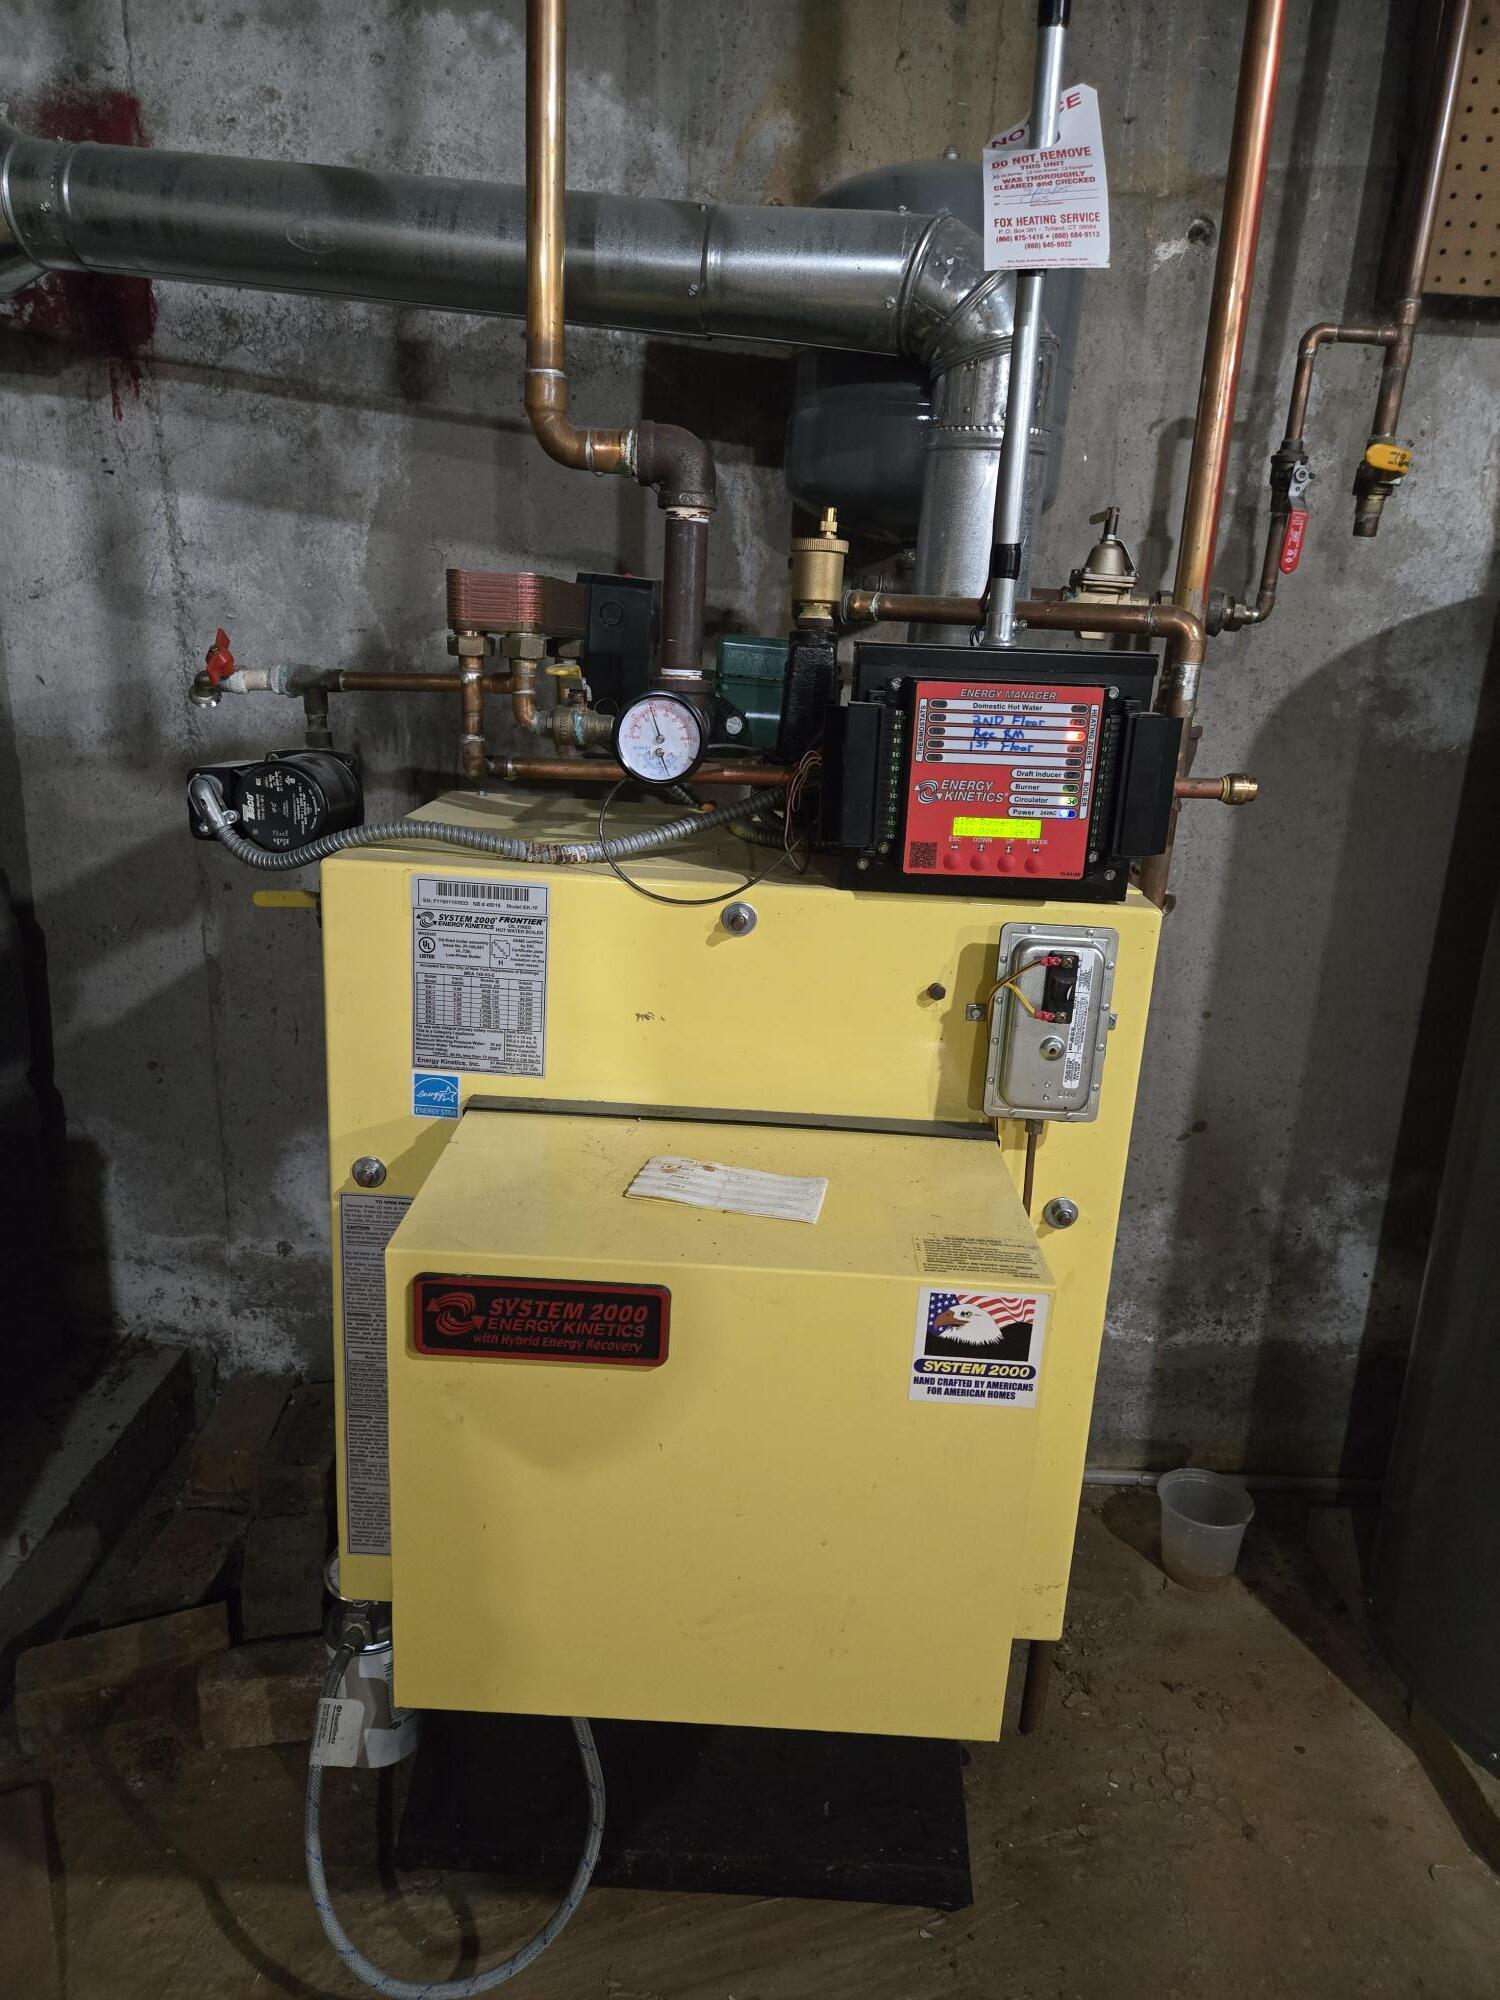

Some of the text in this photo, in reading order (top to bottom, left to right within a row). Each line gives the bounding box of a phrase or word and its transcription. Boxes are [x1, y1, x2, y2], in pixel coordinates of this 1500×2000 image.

[992, 146, 1092, 170] DO NOT REMOVE
[1020, 163, 1042, 171] THIS
[1026, 170, 1086, 182] THOROUGHLY
[994, 181, 1034, 191] CLEANED
[1055, 176, 1096, 186] CHECKED
[994, 212, 1100, 228] FOX HEATING SERVICE
[960, 688, 1057, 700] ENERGY MANAGER
[1012, 716, 1046, 726] Floor
[1089, 709, 1098, 740] HEATING
[917, 704, 926, 756] THERMOSTATS
[974, 728, 1025, 740] Rec RM
[1000, 740, 1034, 752] Floor
[941, 780, 993, 790] ENERGY
[944, 792, 1004, 802] KINETICS
[1081, 782, 1089, 807] BOILER
[438, 914, 543, 925] SYSTEM 2000 FRONTIER
[422, 940, 432, 950] UL
[490, 1298, 648, 1322] SYSTEM 2000
[488, 1318, 645, 1338] ENERGY KINETICS
[473, 1333, 642, 1352] with Hybrid Energy Recovery
[922, 1360, 1030, 1378] SYSTEM 2000
[914, 1376, 1034, 1392] HAND CRAFTED BY AMERICANS
[927, 1386, 1016, 1400] FOR AMERICAN HOMES
